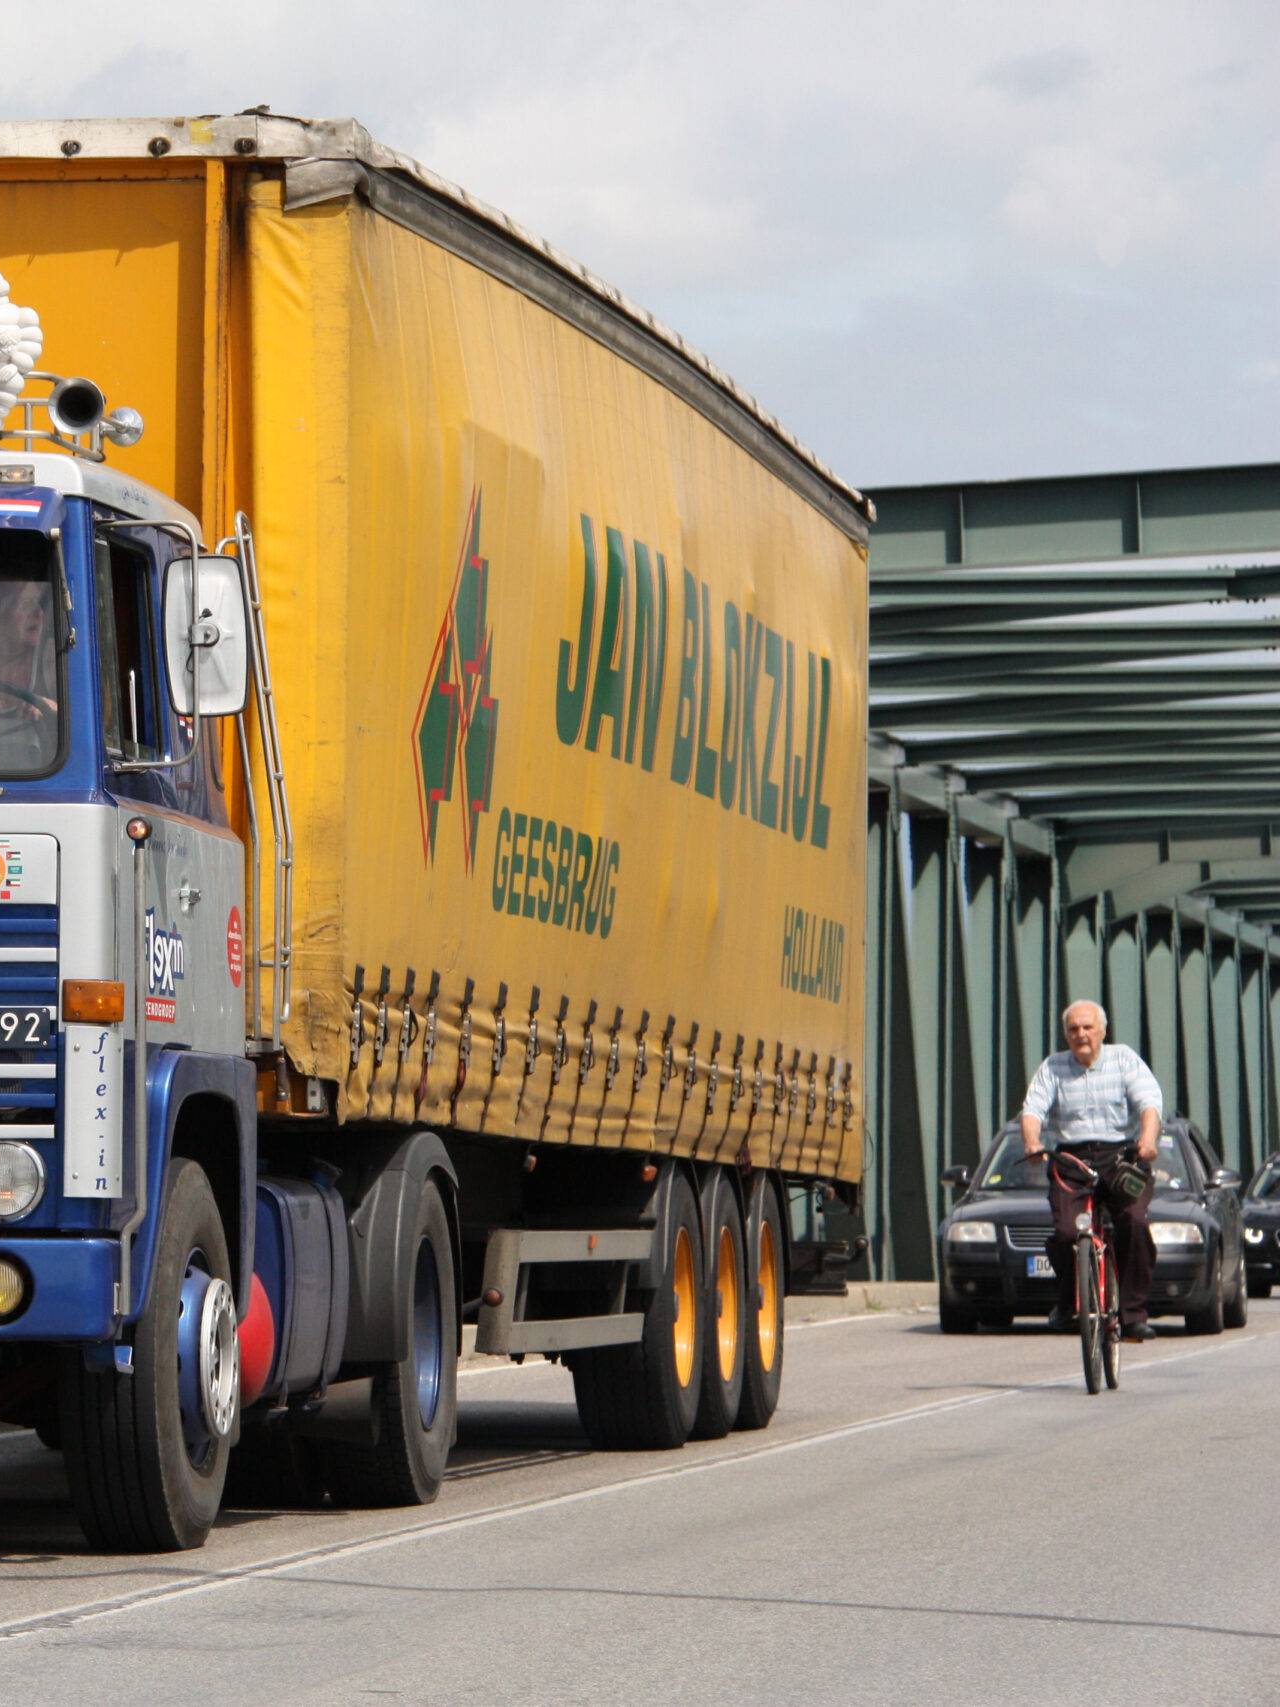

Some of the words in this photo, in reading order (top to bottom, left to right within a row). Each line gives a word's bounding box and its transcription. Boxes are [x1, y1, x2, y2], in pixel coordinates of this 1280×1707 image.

[556, 512, 670, 773] JAN
[670, 567, 834, 850] BLOKZIJL
[492, 806, 620, 939] GEESBRUG
[781, 904, 844, 1003] HOLLAND
[93, 1032, 108, 1191] flex-in
